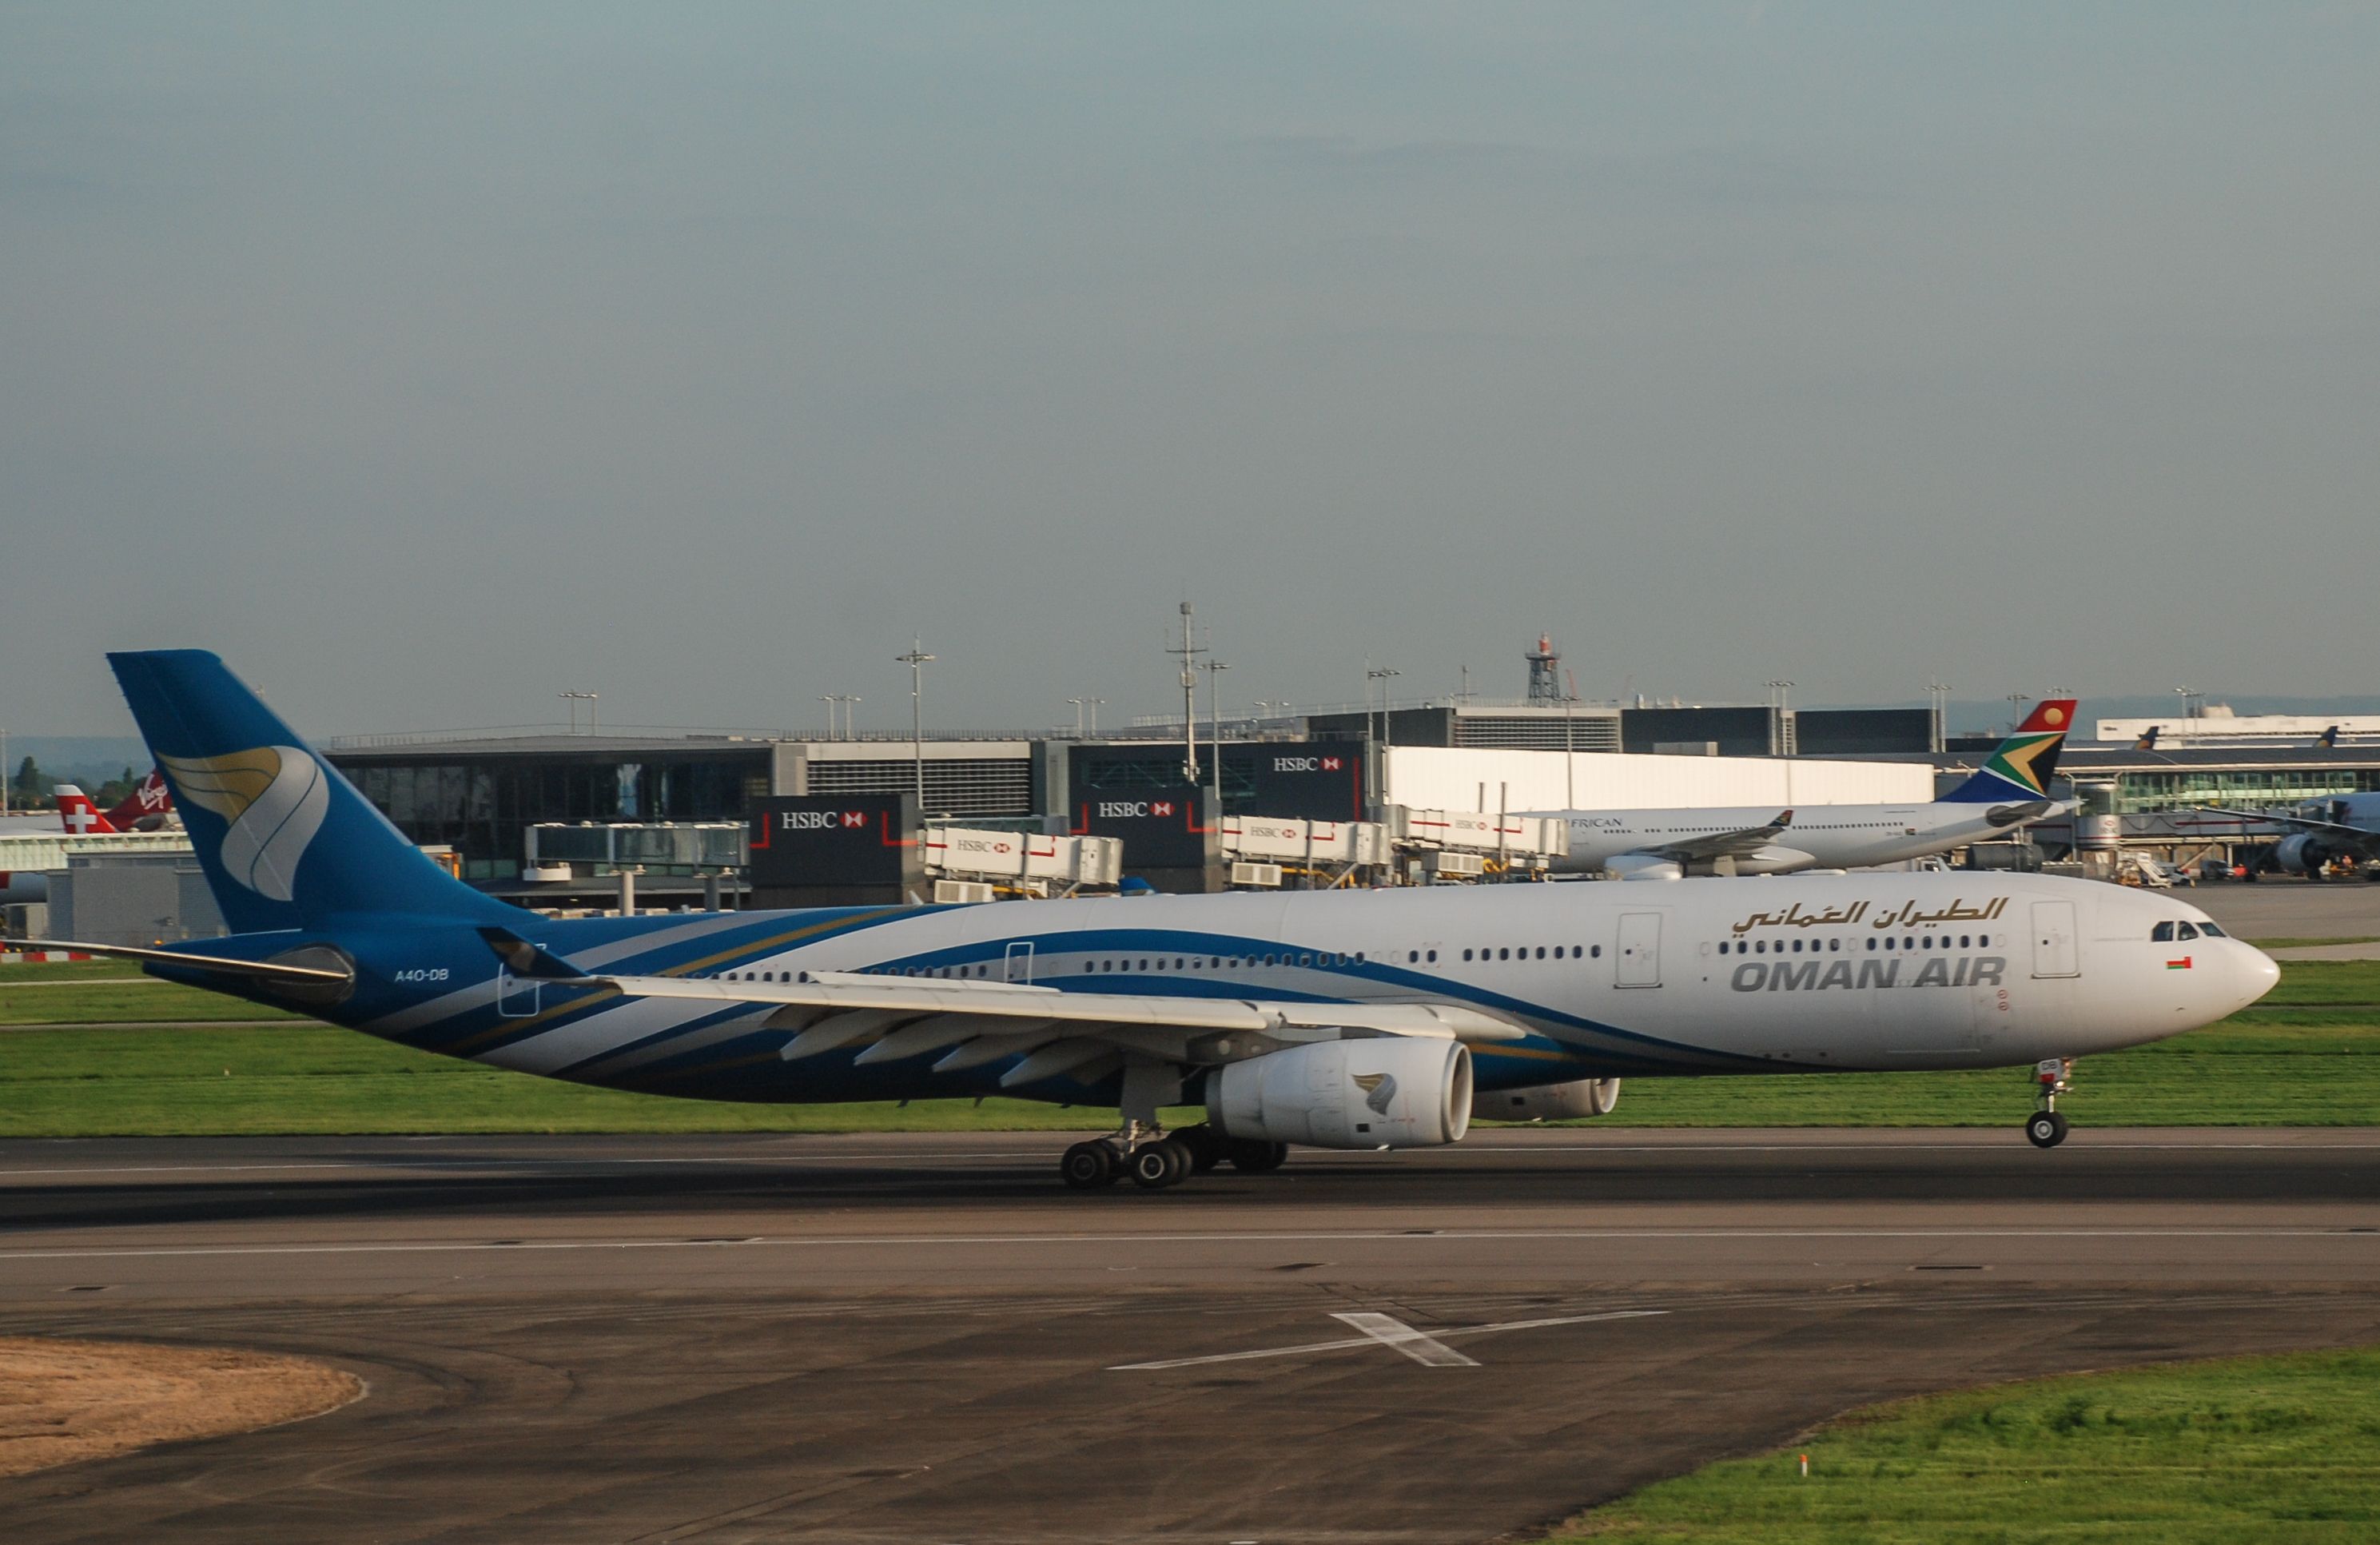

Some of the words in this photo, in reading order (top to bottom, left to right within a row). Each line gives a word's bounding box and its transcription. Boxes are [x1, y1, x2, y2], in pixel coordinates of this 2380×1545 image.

[1274, 757, 1319, 771] HSBC
[1099, 801, 1148, 818] HSBC
[782, 811, 838, 829] HSBC
[1571, 818, 1622, 828] FRICAN
[1251, 826, 1280, 838] HSBC
[957, 839, 992, 852] HSBC
[1873, 897, 2010, 929] الطيران
[1731, 958, 1900, 992] OMAN
[1912, 956, 2007, 987] AIR
